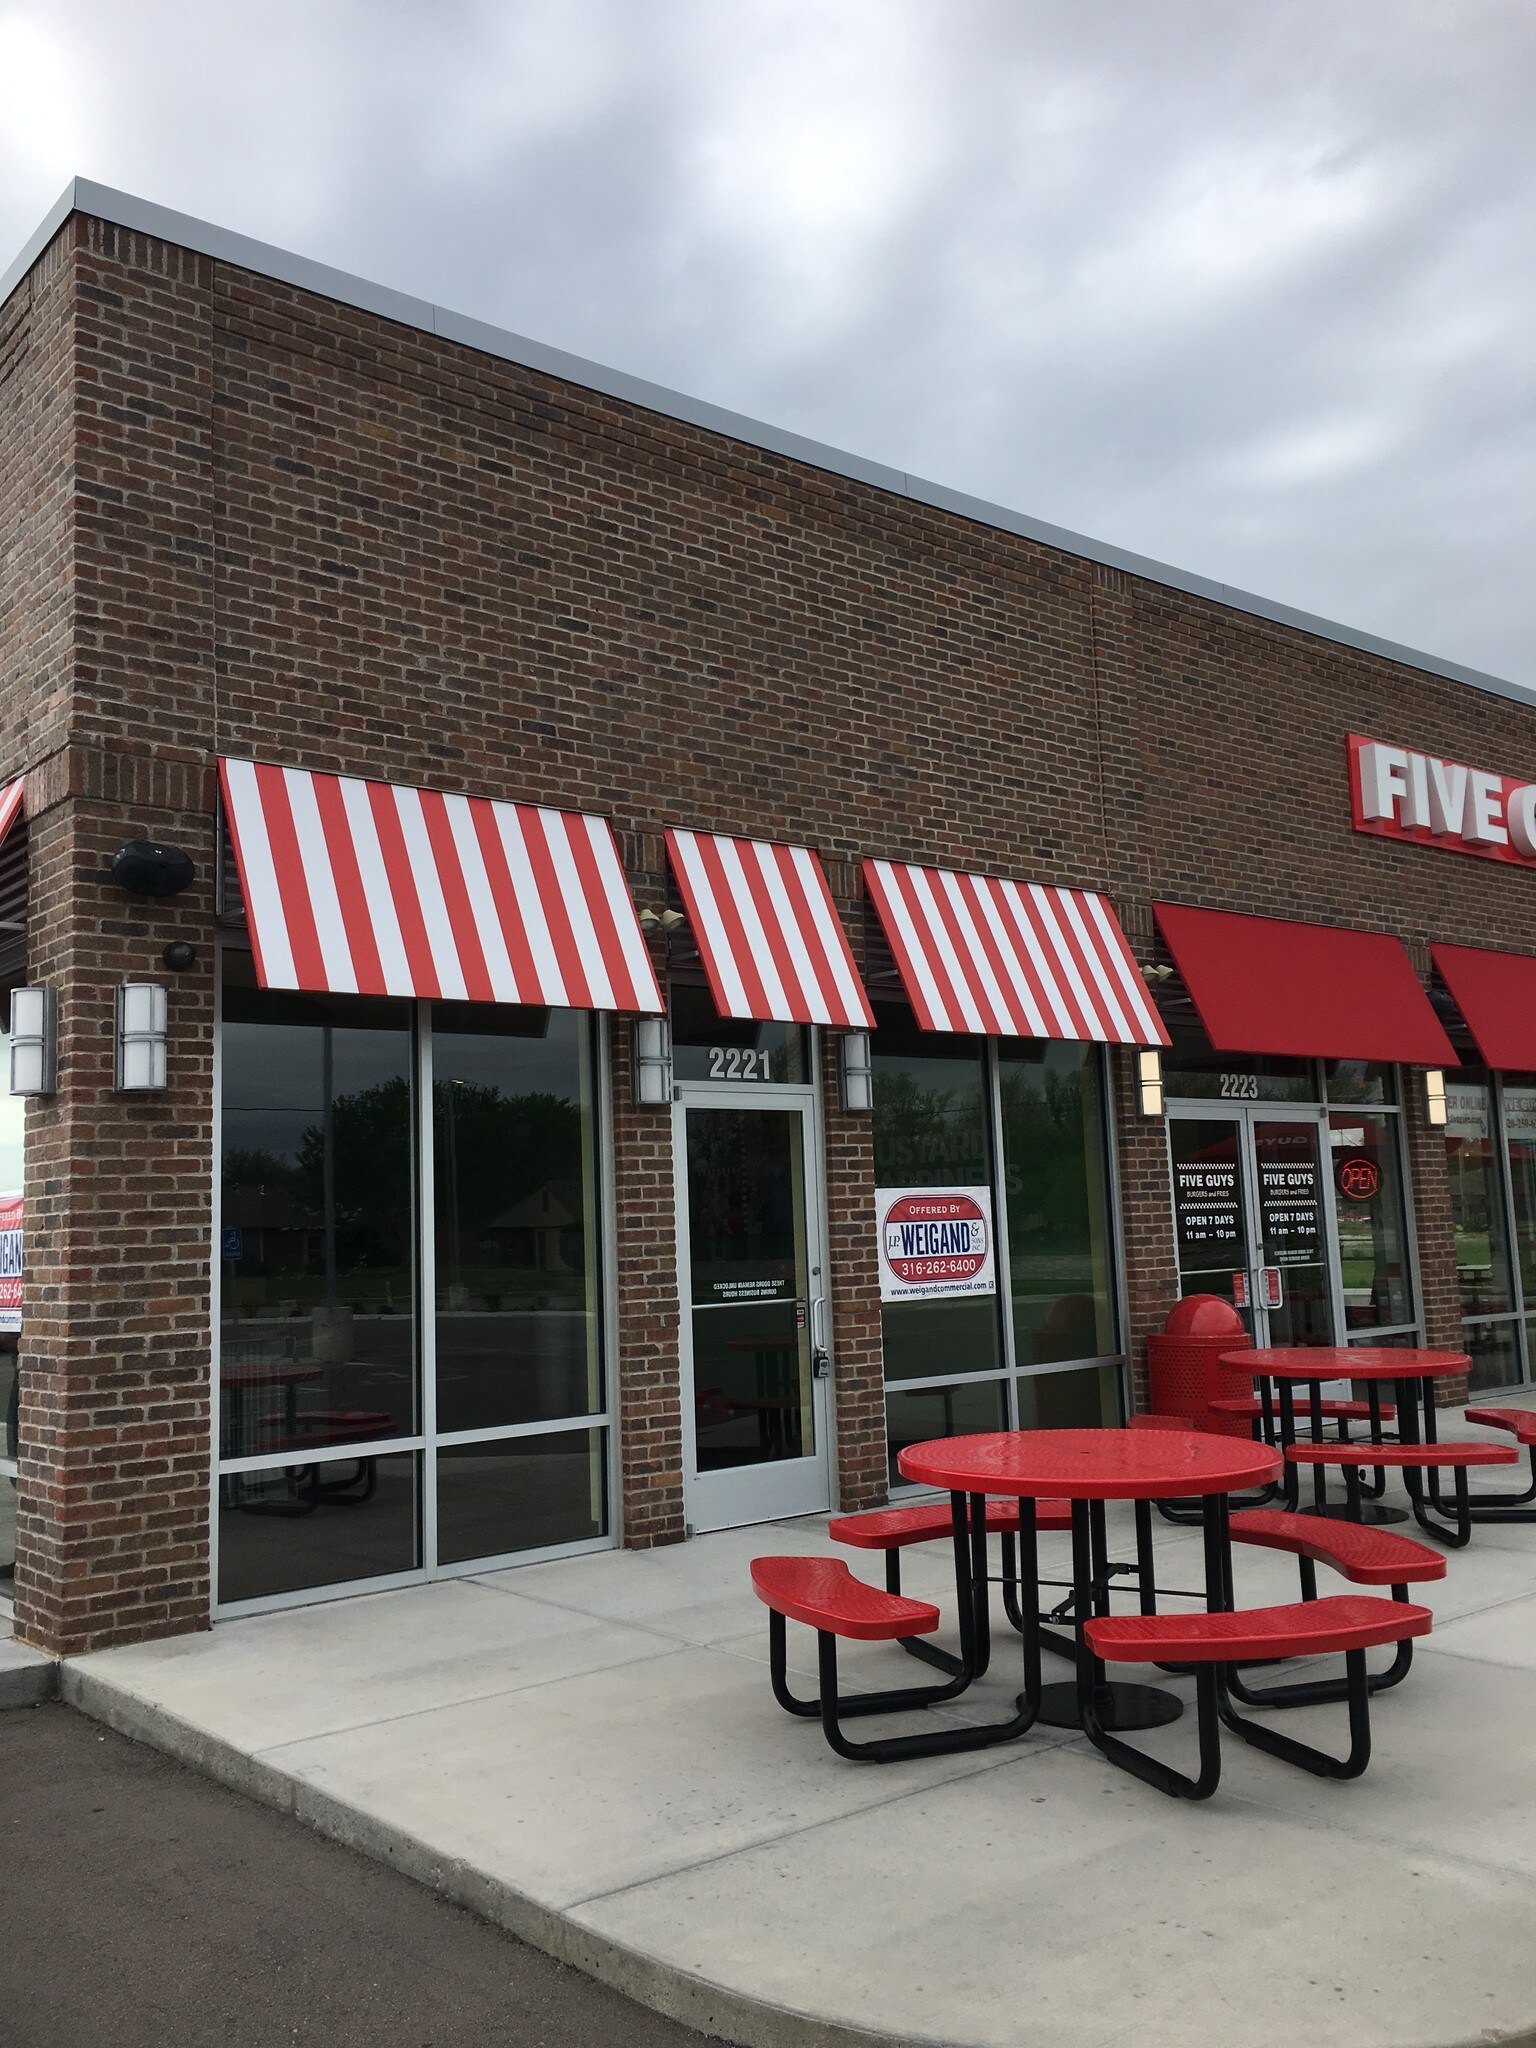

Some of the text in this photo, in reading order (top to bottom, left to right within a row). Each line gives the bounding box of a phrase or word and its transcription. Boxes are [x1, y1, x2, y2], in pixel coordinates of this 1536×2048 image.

[1358, 742, 1509, 845] FIVE
[709, 1047, 770, 1080] 2221
[1220, 1074, 1258, 1099] 2223
[1179, 1174, 1235, 1187] FIVE GUYS
[1263, 1173, 1314, 1185] FIVE GUYS
[1341, 1168, 1378, 1189] OPEN
[909, 1205, 947, 1215] OFFERED
[1185, 1215, 1234, 1226] OPEN 7 DAYS
[1269, 1212, 1314, 1222] OPEN 7 DAYS
[1186, 1230, 1194, 1239] 11
[1195, 1231, 1206, 1239] am
[1216, 1229, 1224, 1238] 10
[1225, 1230, 1236, 1239] pm
[1269, 1226, 1277, 1235] 11
[1278, 1227, 1289, 1235] am
[1297, 1225, 1305, 1234] 10
[1305, 1226, 1316, 1235] pm
[887, 1221, 979, 1256] J.P. WEIGAND &
[902, 1259, 976, 1276] 316-262-6400
[891, 1283, 987, 1296] www.weigandcommercial.com
